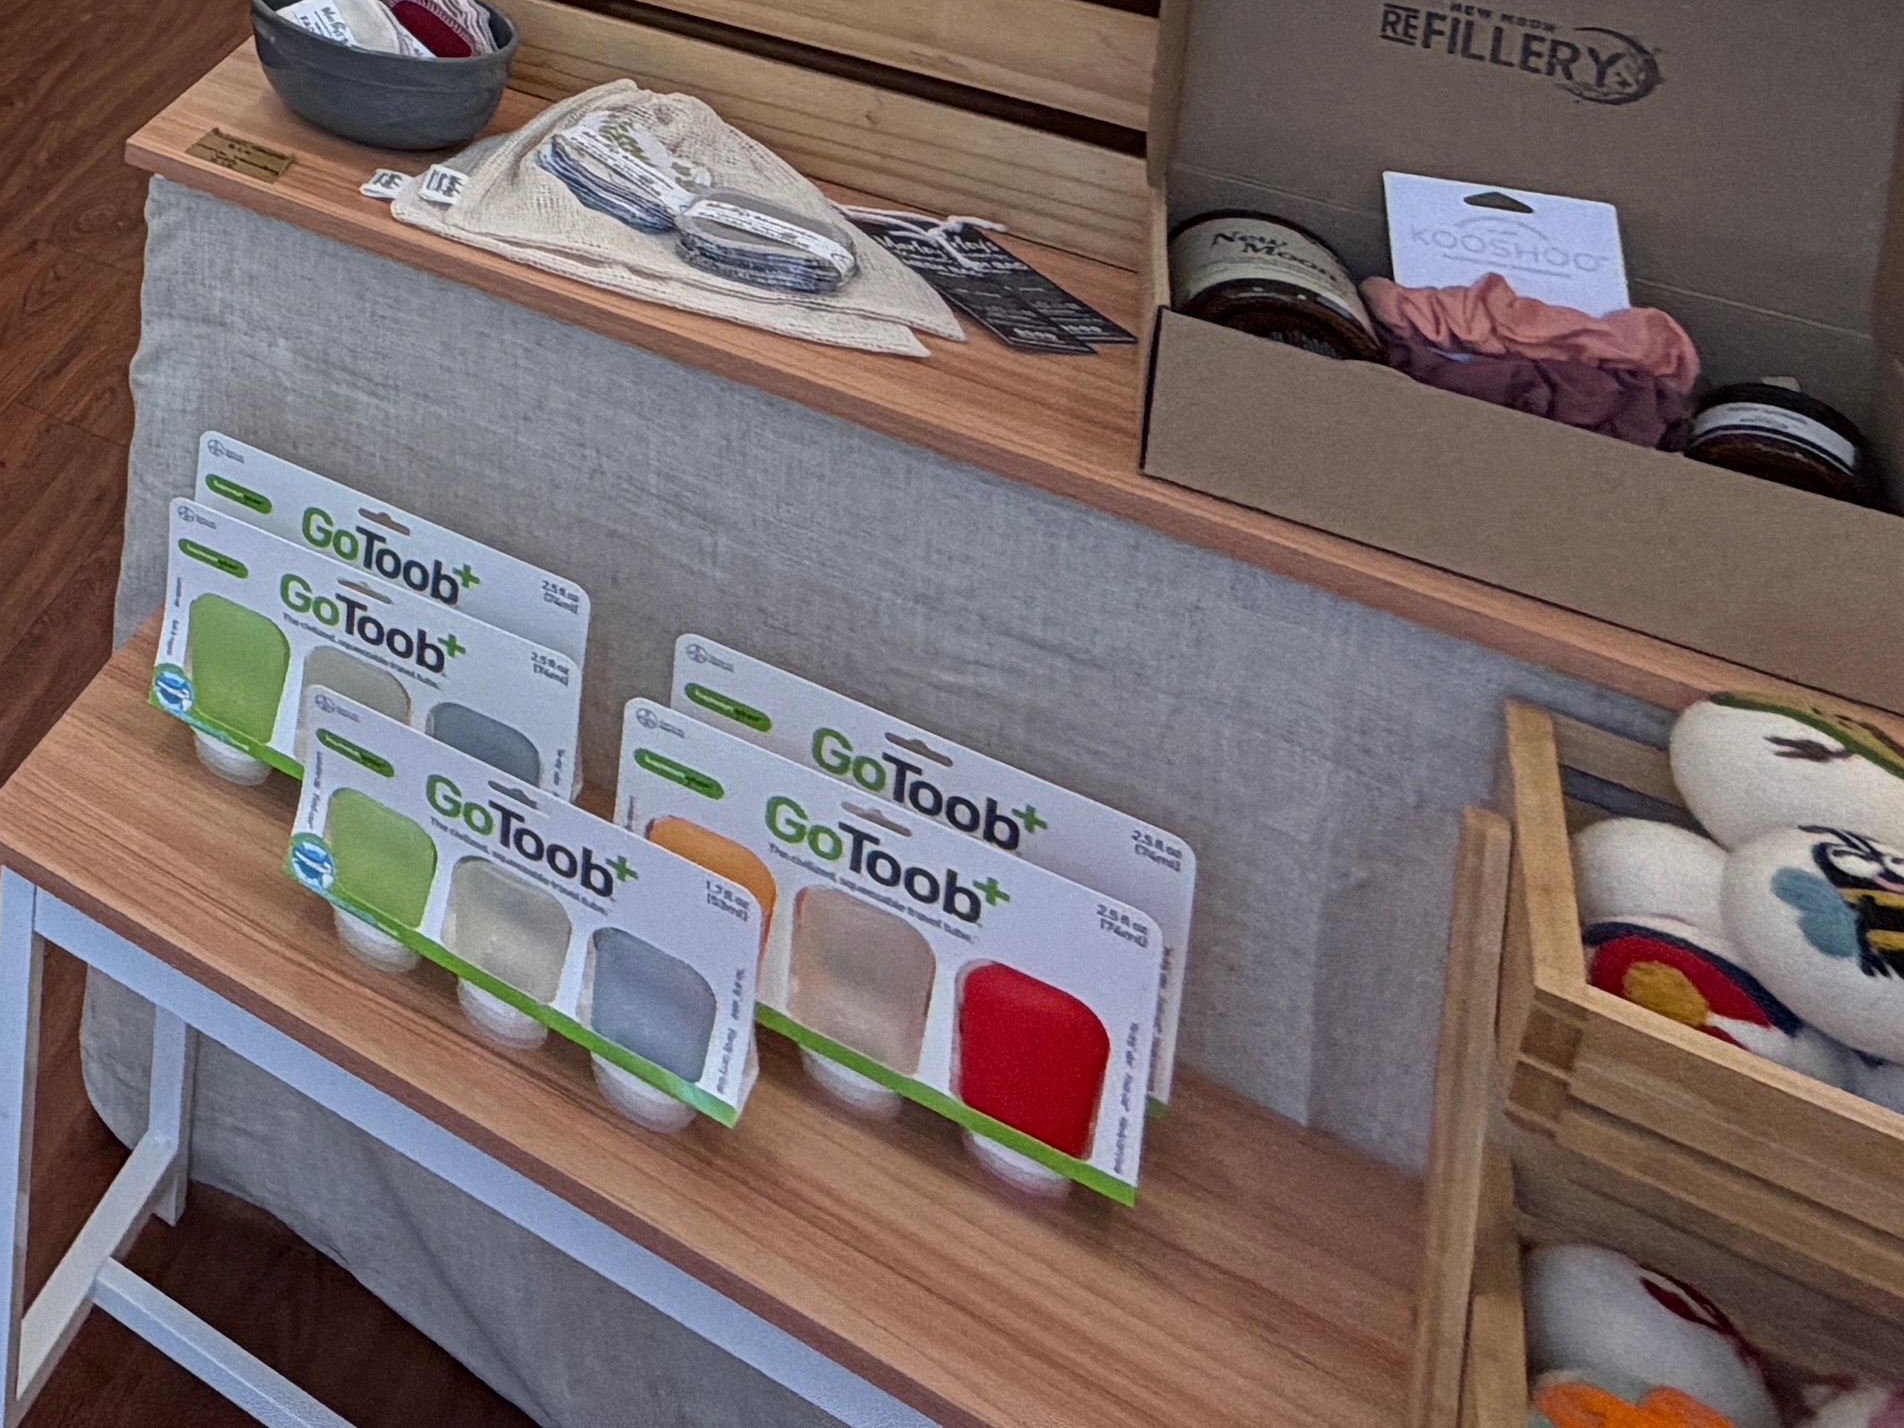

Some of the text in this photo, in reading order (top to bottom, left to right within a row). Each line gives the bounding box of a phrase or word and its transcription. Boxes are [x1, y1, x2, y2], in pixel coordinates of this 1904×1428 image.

[1501, 11, 1557, 34] MOON
[1380, 5, 1625, 90] REFILLERY
[1210, 228, 1286, 251] New
